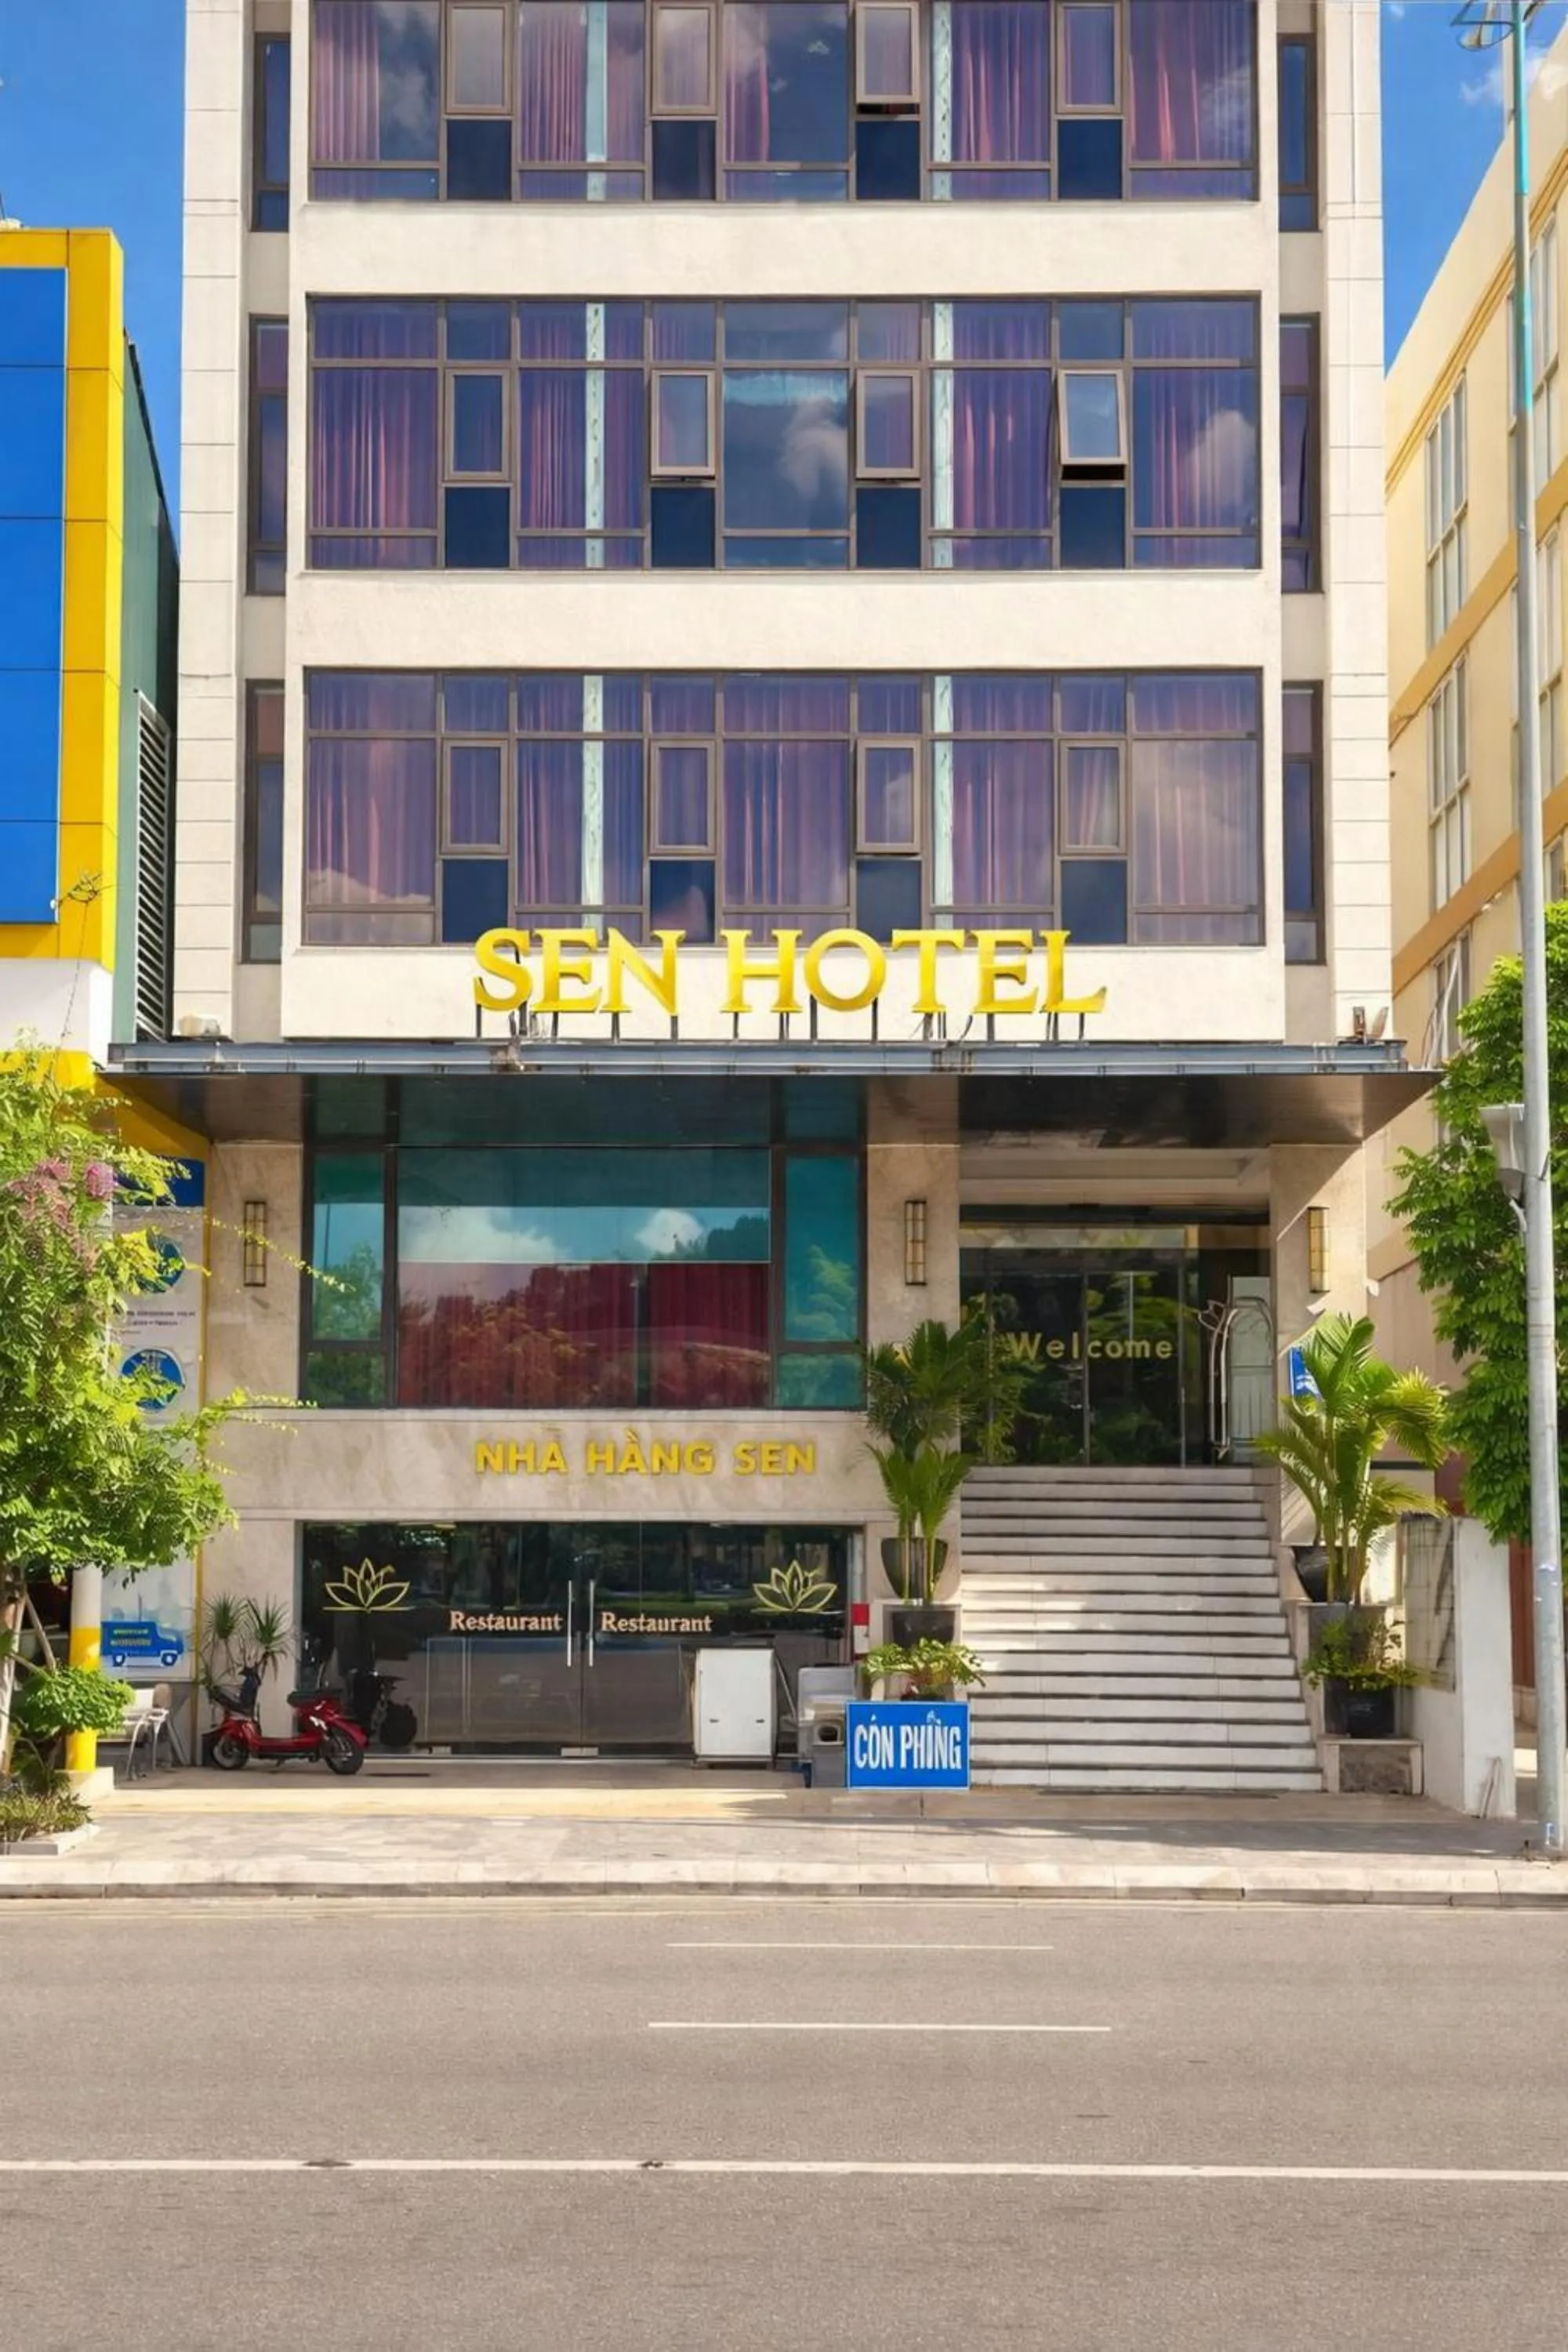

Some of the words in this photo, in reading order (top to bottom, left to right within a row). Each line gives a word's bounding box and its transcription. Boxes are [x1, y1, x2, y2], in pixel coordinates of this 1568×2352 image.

[474, 927, 686, 1017] SEN
[719, 927, 1108, 1014] HOTEL
[1007, 1331, 1174, 1360] Welcome
[732, 1439, 817, 1475] SEN
[449, 1610, 563, 1632] Restaurant
[601, 1610, 713, 1633] Restaurant
